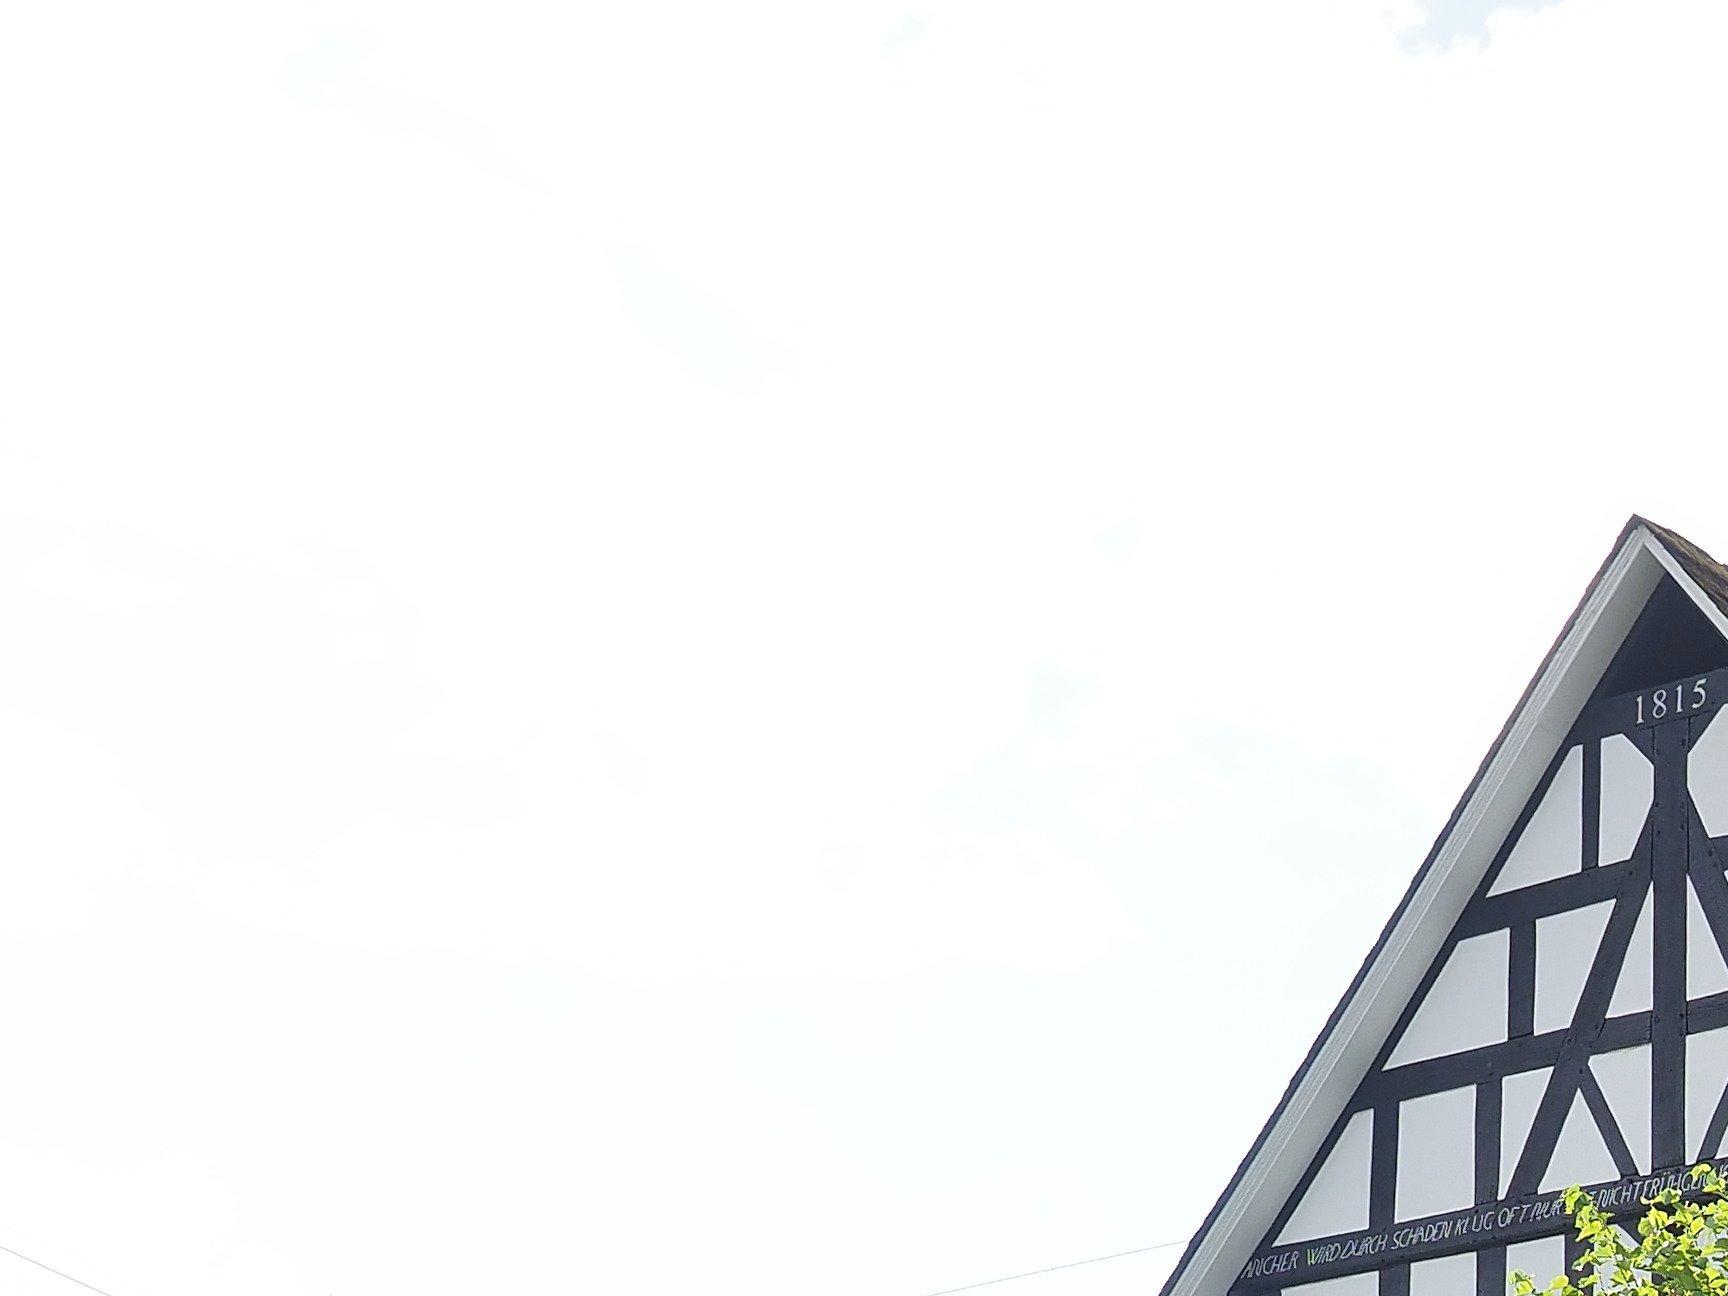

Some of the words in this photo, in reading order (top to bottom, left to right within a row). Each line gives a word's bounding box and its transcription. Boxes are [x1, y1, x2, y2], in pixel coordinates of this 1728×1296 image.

[1636, 678, 1708, 724] 1815
[1240, 1250, 1299, 1279] ANCHER
[1390, 1220, 1453, 1250] SCHADEN
[1454, 1210, 1494, 1235] KLUG
[1498, 1203, 1532, 1227] OFT
